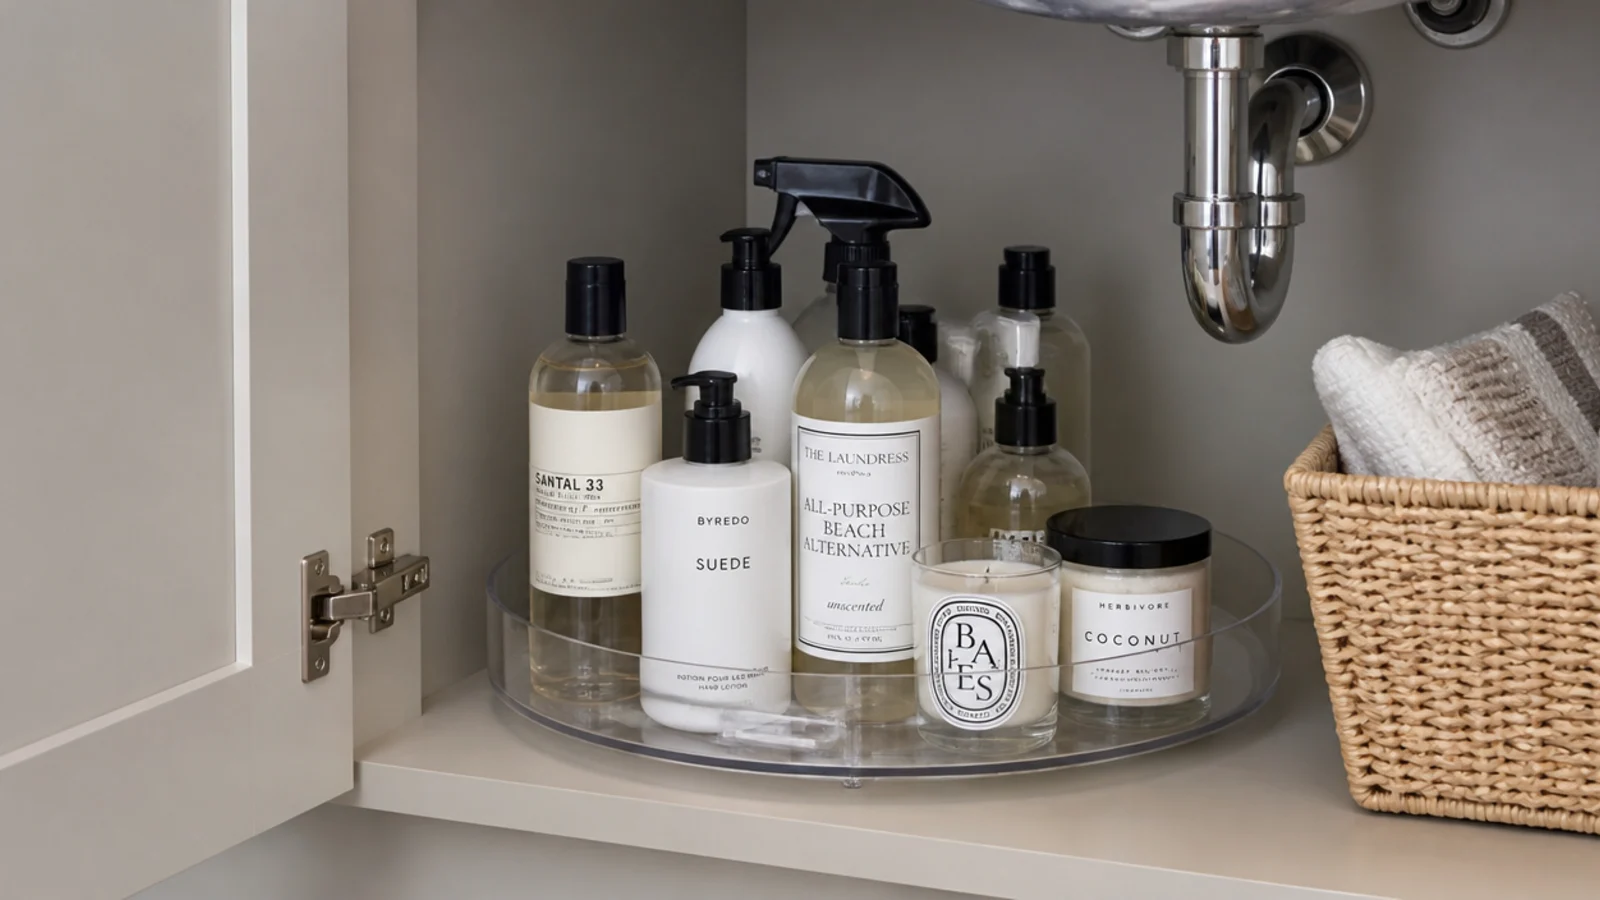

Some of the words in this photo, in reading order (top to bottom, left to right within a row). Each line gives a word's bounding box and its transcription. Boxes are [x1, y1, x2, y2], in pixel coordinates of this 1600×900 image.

[804, 446, 825, 461] THE
[828, 451, 910, 465] LAUNDRESS
[535, 472, 581, 491] SANTAL
[586, 478, 604, 492] 33
[804, 497, 911, 518] ALL-PURPOSE
[697, 515, 750, 526] BYREDO
[823, 520, 886, 538] BEACH
[803, 536, 911, 558] ALTERNATIVE
[696, 556, 751, 571] SUEDE
[827, 598, 885, 612] unscented
[1084, 631, 1180, 647] COCONUT
